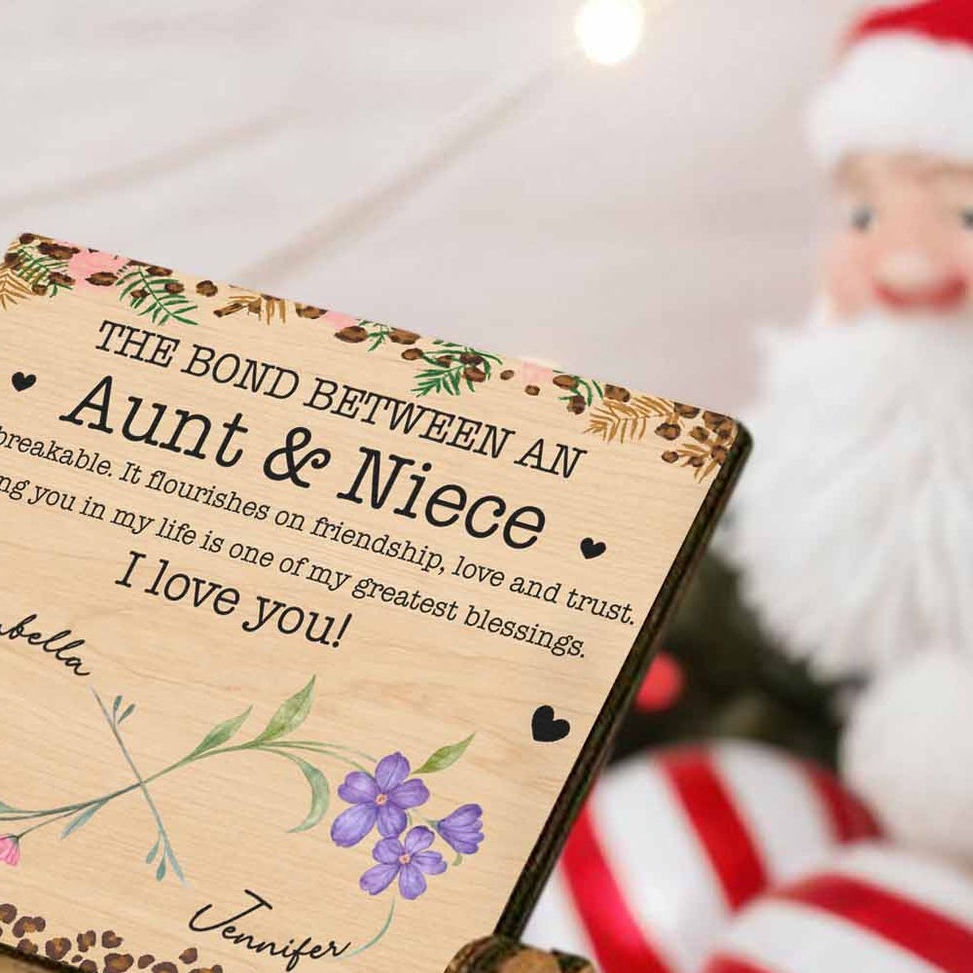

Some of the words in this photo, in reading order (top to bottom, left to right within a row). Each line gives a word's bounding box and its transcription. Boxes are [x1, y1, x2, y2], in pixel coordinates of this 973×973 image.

[59, 376, 249, 468] Aunt
[263, 427, 331, 489] &
[337, 447, 546, 549] Niece
[95, 319, 181, 368] THE
[181, 344, 300, 400] BOND
[303, 377, 516, 459] BETWEEN
[514, 438, 587, 479] AN
[28, 486, 76, 511] you
[79, 496, 106, 520] in
[110, 509, 155, 534] my
[156, 517, 197, 546] life
[199, 529, 225, 553] is
[229, 544, 274, 567] one
[280, 557, 310, 577] of
[310, 565, 352, 591] my
[352, 578, 459, 621] greatest
[464, 605, 585, 657] blessings.
[115, 551, 147, 587] I
[145, 559, 240, 616] love
[242, 596, 353, 648] you!
[119, 462, 142, 485] It
[145, 470, 270, 521] flourishes
[275, 511, 304, 531] on
[310, 516, 445, 575] friendship,
[451, 556, 505, 587] love
[510, 576, 562, 604] and
[567, 588, 635, 625] trust.
[189, 889, 352, 972] Jennifer
